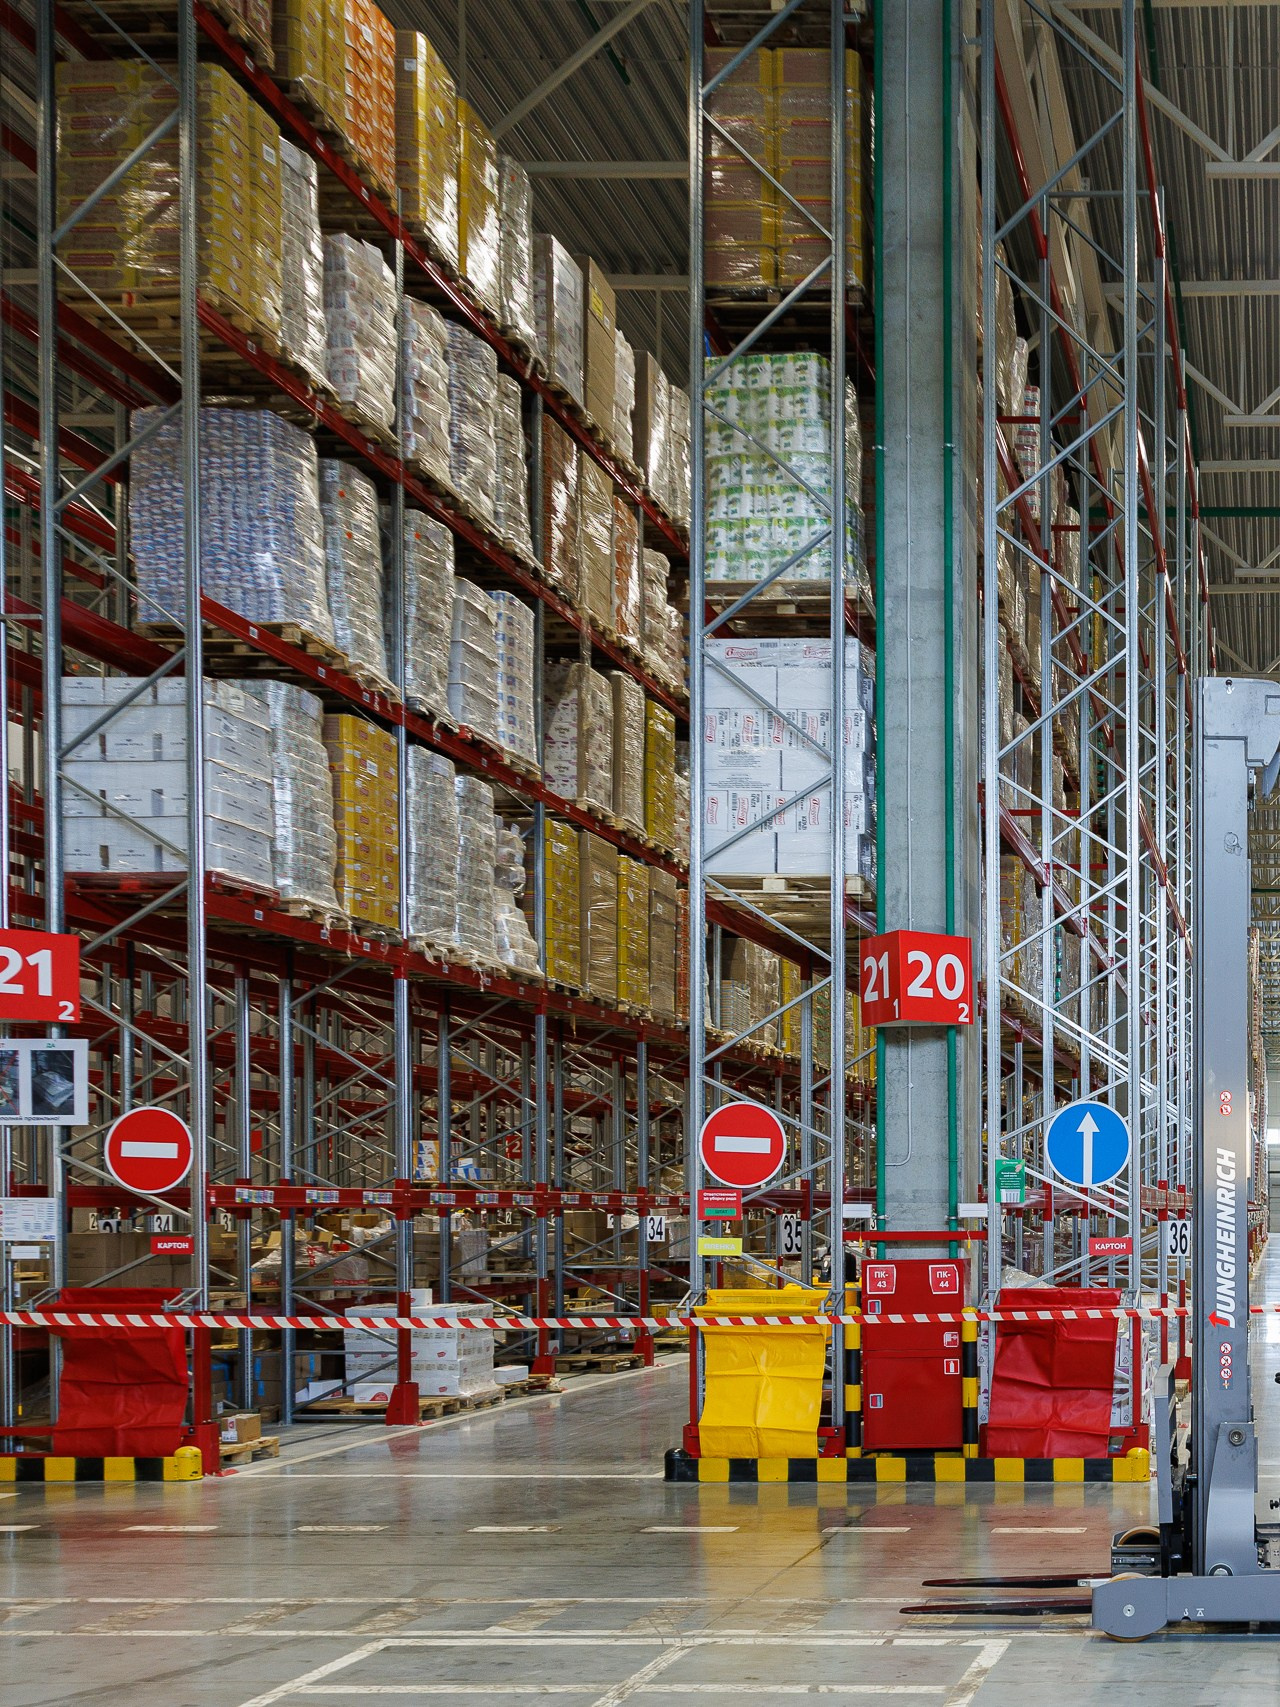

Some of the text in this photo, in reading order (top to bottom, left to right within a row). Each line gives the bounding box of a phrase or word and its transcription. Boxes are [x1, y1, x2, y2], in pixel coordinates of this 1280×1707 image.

[0, 945, 53, 997] 21
[863, 951, 890, 1003] 21
[907, 950, 965, 1001] 20
[58, 1000, 75, 1021] 2
[893, 998, 899, 1019] 1
[958, 1003, 970, 1023] 2
[648, 1217, 663, 1240] 34
[1170, 1222, 1188, 1255] 36
[1216, 1148, 1236, 1328] JUNGHEINRICH
